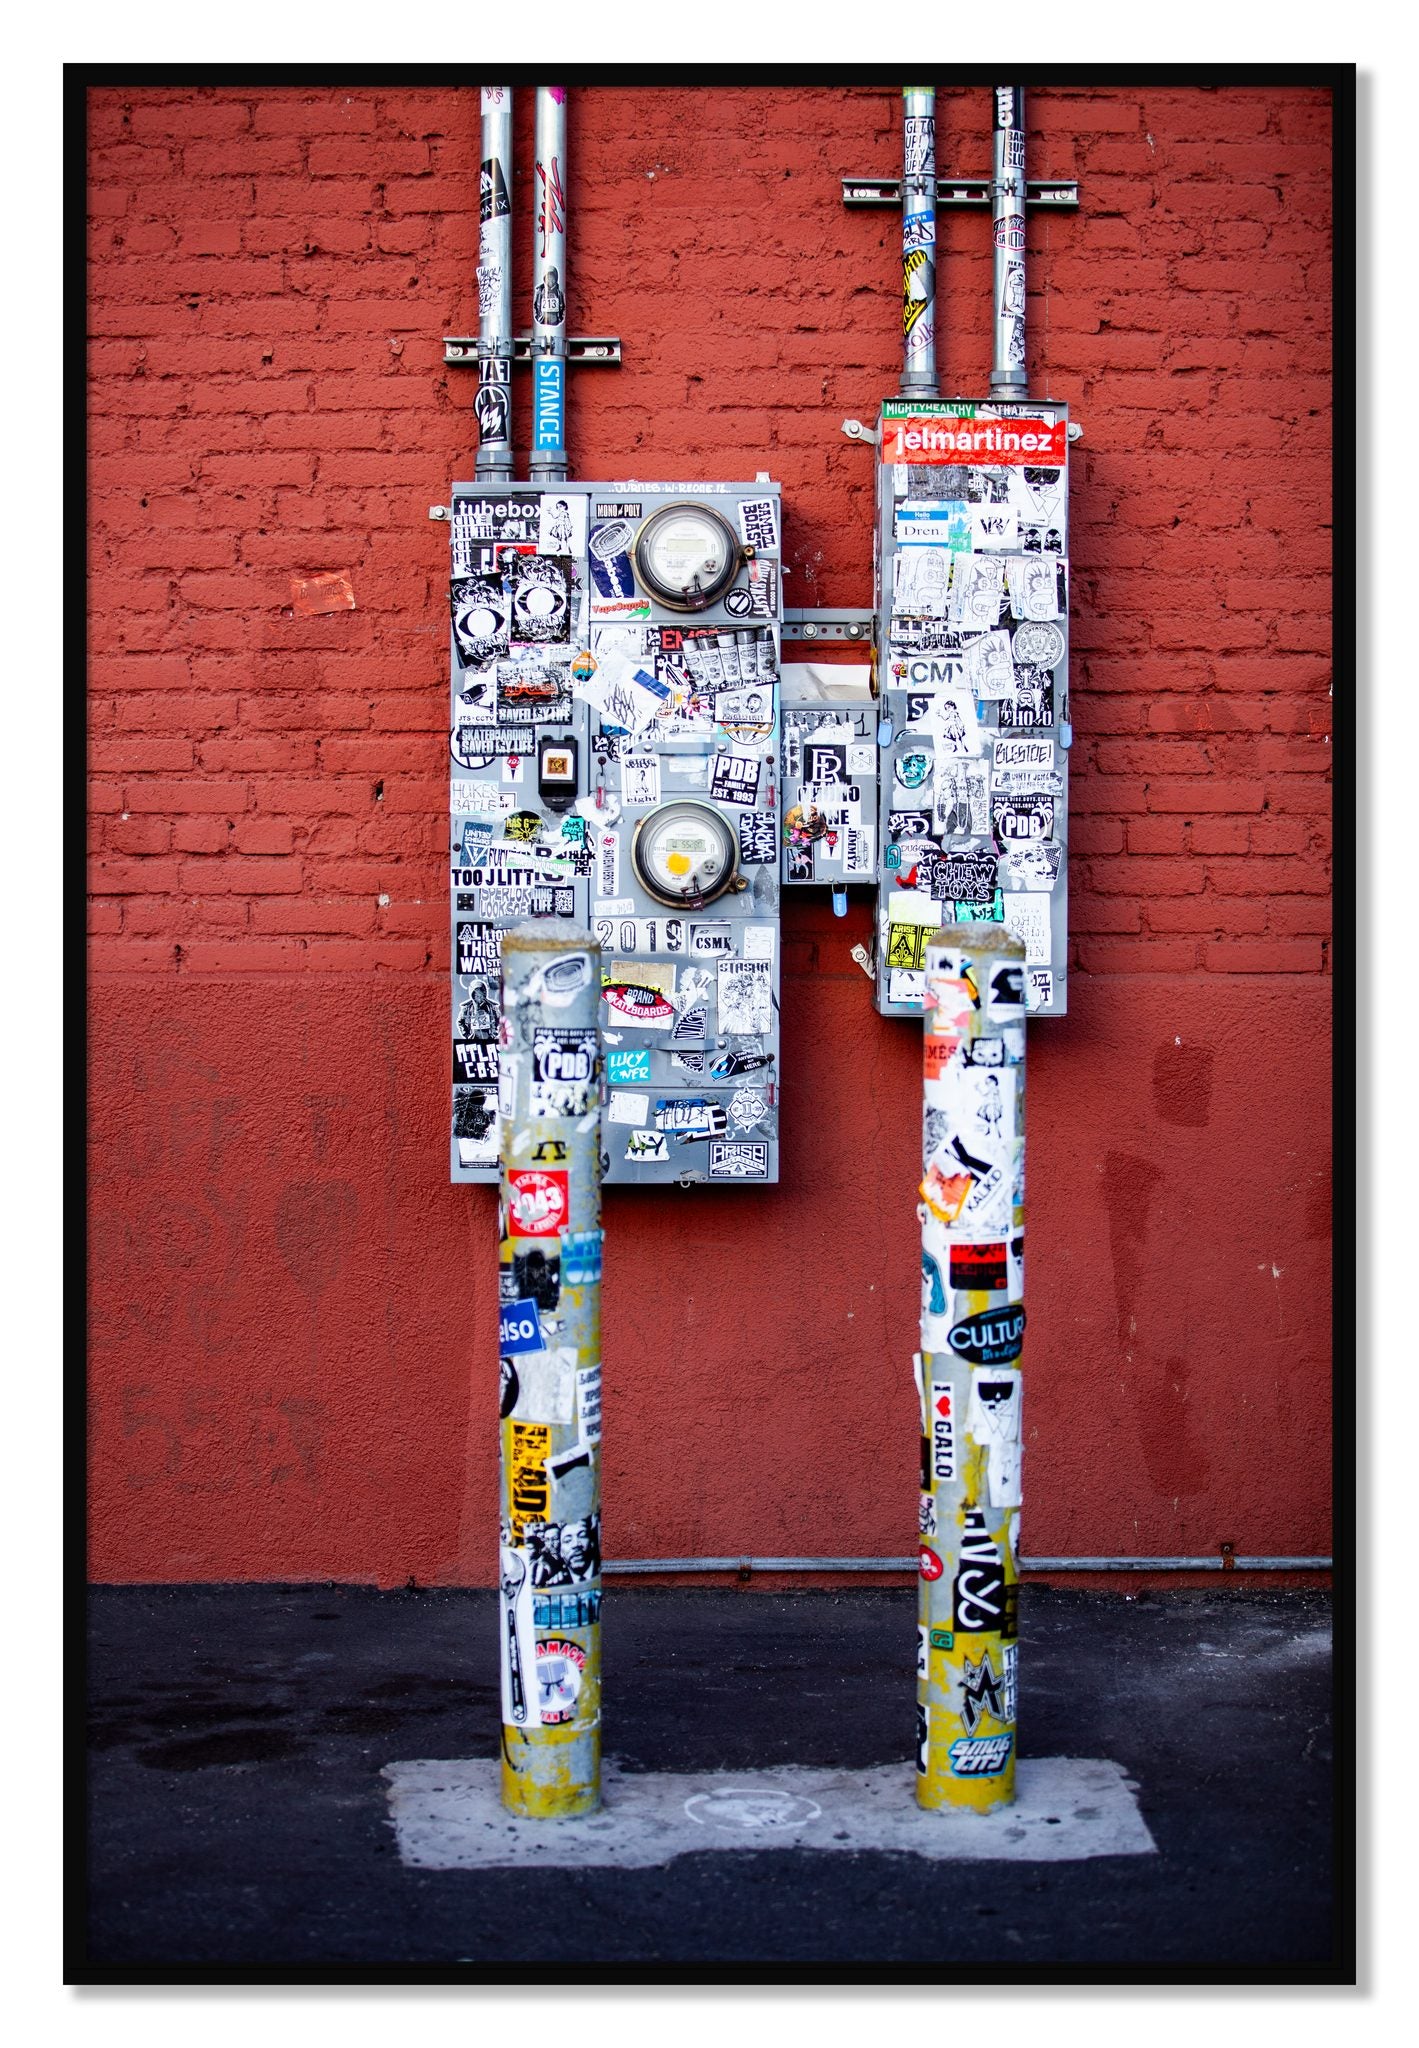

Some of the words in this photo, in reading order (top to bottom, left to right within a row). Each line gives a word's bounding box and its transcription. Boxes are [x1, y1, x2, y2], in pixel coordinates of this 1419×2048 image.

[540, 364, 560, 446] STANCE
[896, 427, 1052, 455] jelmartinez
[598, 504, 618, 518] MONO
[624, 504, 642, 518] POLY
[742, 504, 763, 550] BOAST
[715, 755, 760, 784] PDB
[712, 787, 730, 800] EST.
[732, 790, 754, 803] 1993
[724, 780, 746, 791] FAMILY
[1005, 815, 1041, 837] PDB
[452, 868, 483, 886] TOO
[933, 861, 995, 883] CHEW
[935, 880, 990, 901] TOYS
[893, 924, 916, 935] ARISE
[696, 936, 732, 951] CSMK
[551, 1052, 589, 1079] PDB
[713, 1144, 765, 1164] ARISE
